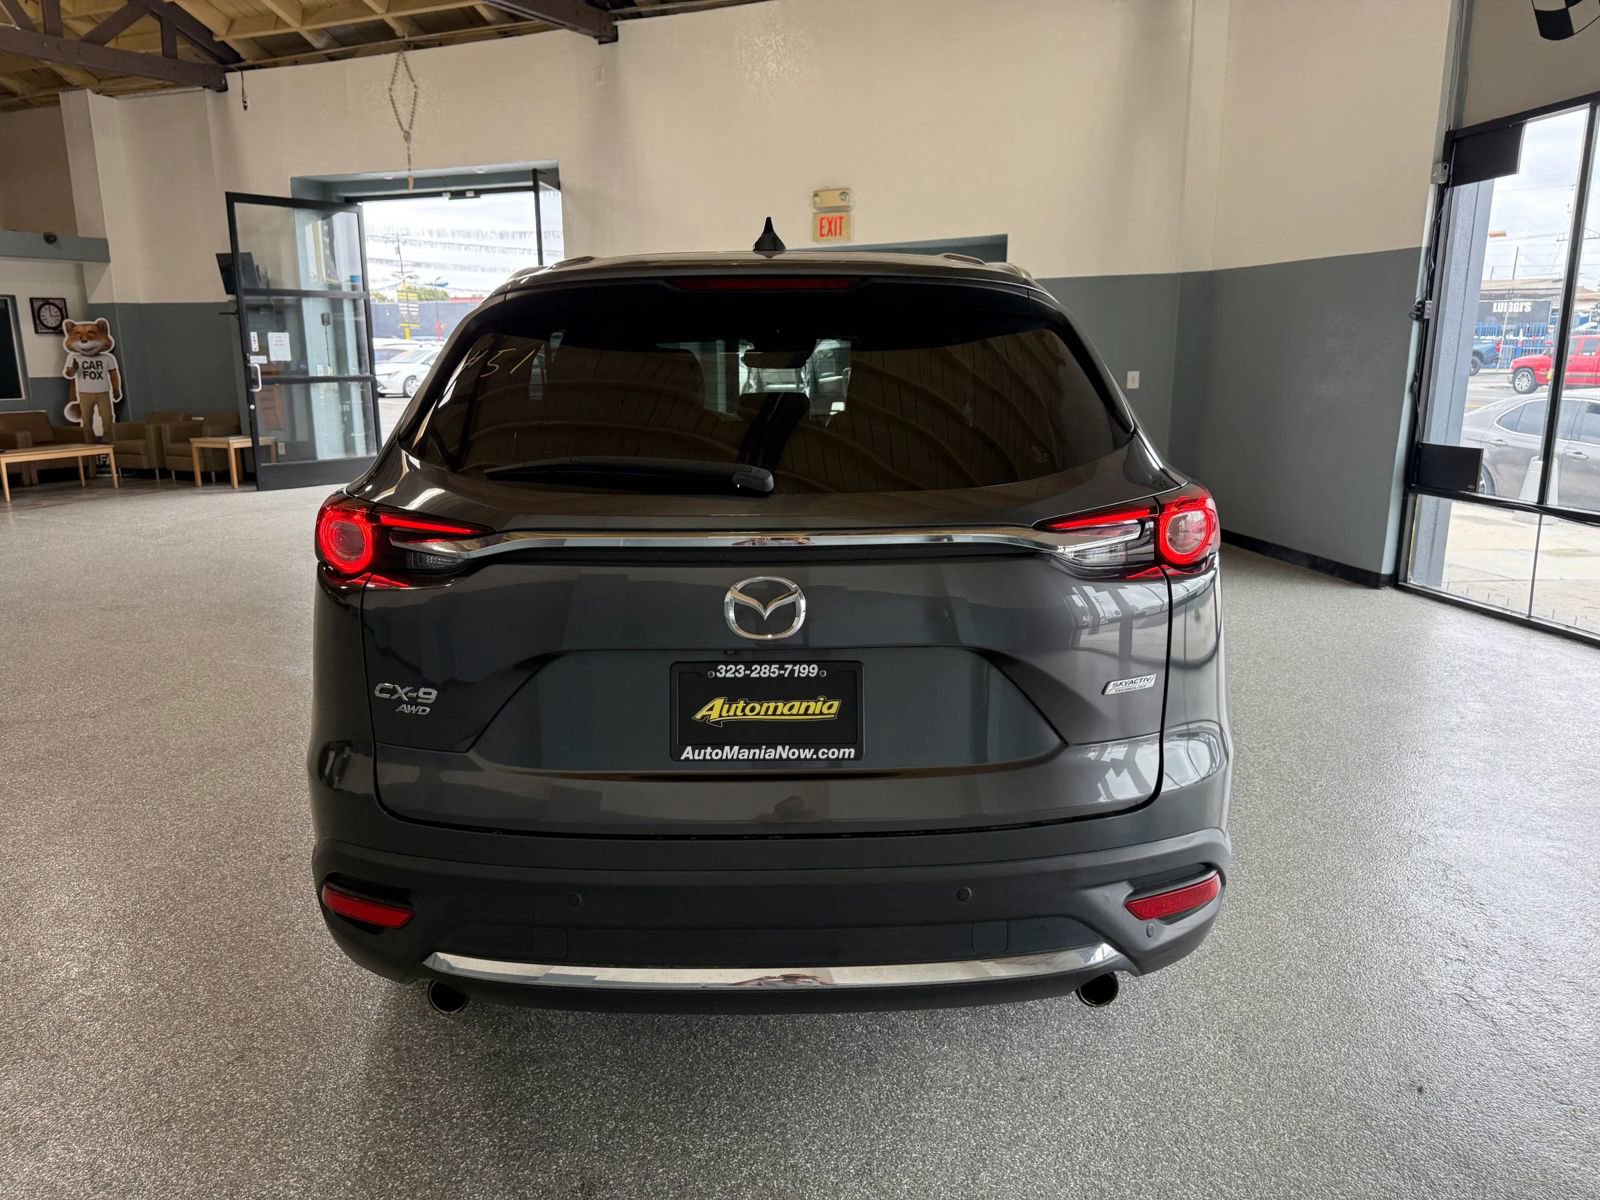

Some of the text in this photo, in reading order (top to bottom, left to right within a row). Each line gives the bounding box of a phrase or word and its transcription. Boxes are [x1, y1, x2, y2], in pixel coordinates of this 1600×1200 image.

[819, 215, 844, 237] EXIT
[81, 360, 104, 370] CAR
[83, 370, 104, 380] FOX
[716, 664, 818, 678] 323-285-7199
[1112, 676, 1153, 687] SKYACTIV
[374, 682, 438, 704] CX-9
[395, 703, 431, 715] AWD
[692, 695, 842, 724] Automania
[680, 745, 855, 760] AutoManiaNow.com
